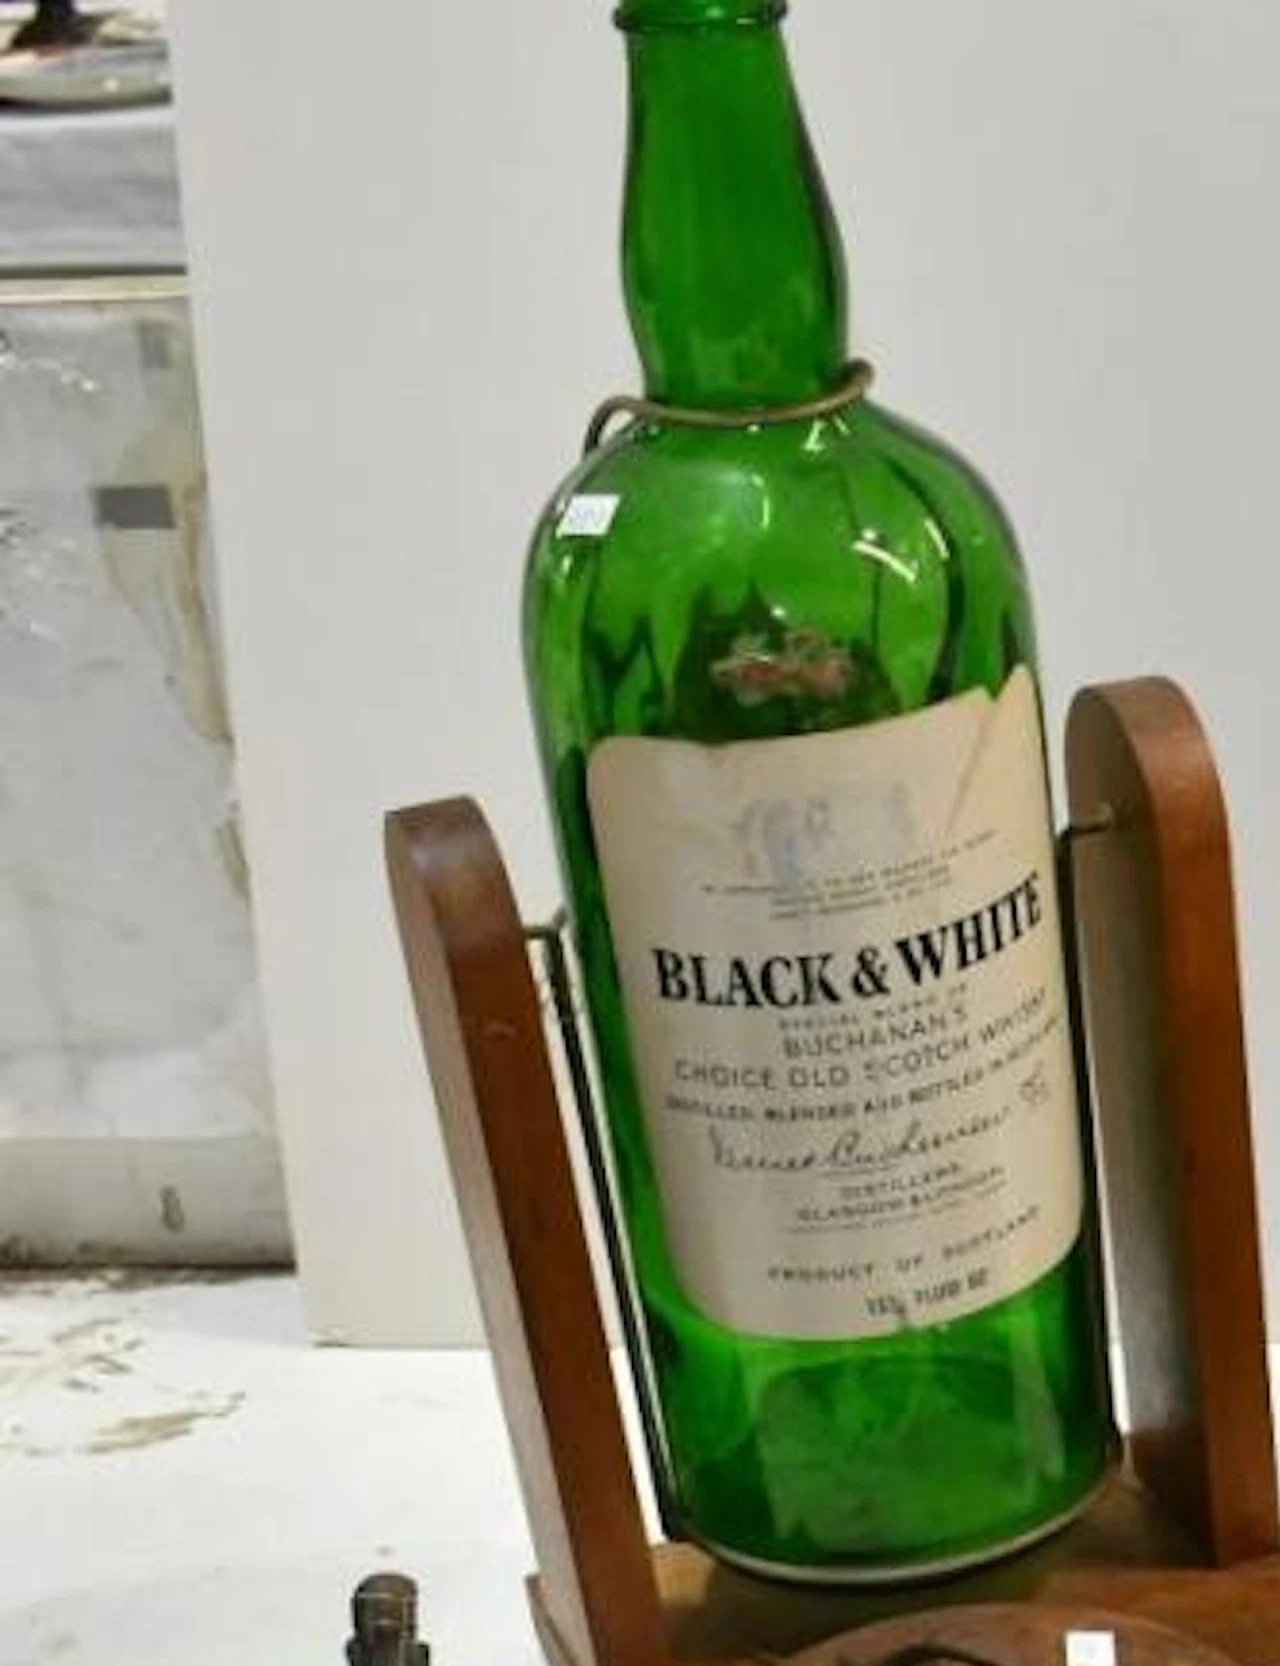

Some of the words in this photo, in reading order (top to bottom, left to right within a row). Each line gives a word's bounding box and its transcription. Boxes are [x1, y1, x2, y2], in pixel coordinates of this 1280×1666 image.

[651, 946, 842, 1010] BLACK
[850, 944, 892, 999] &
[893, 868, 1043, 987] WHITE
[674, 1057, 778, 1091] CHOICE
[787, 1062, 850, 1090] OLD
[862, 1033, 970, 1084] SCOTCH
[765, 1260, 877, 1285] PRODUCT
